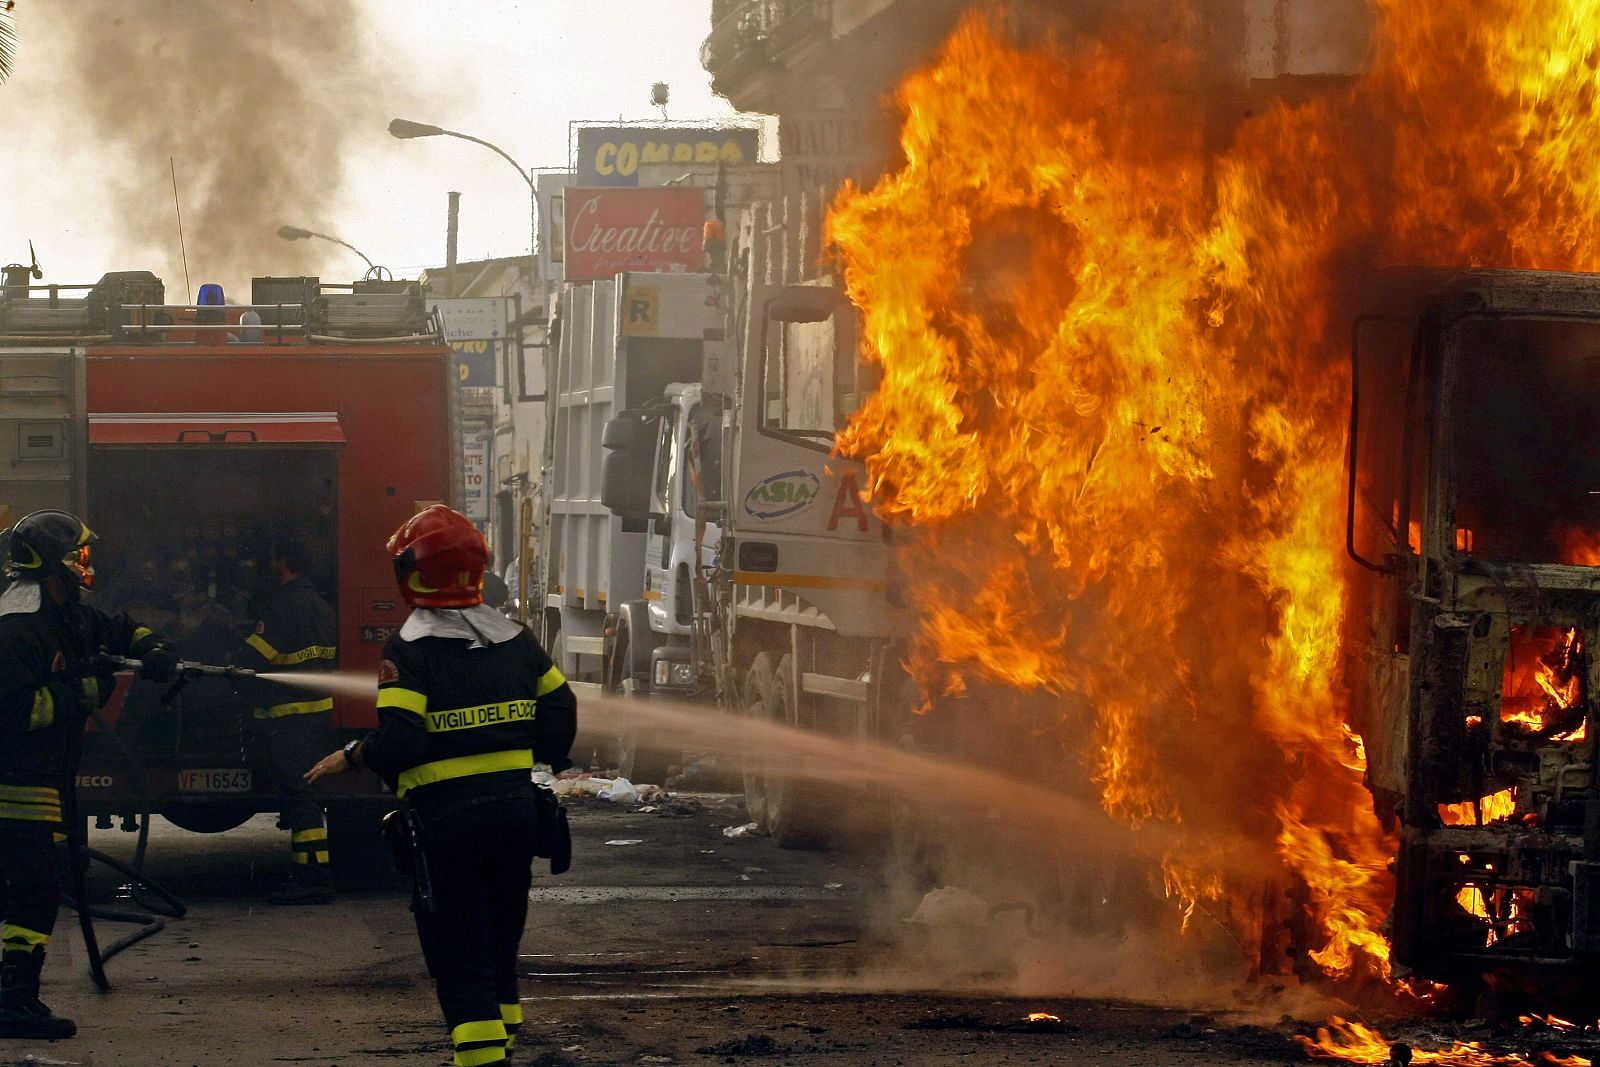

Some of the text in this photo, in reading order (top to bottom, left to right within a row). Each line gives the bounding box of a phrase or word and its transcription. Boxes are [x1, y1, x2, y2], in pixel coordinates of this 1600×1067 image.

[571, 195, 697, 253] Creative
[630, 299, 651, 322] R
[751, 481, 813, 503] ASIA
[432, 708, 475, 729] VIGILI
[478, 706, 505, 723] DEL
[180, 771, 249, 789] VF 16543
